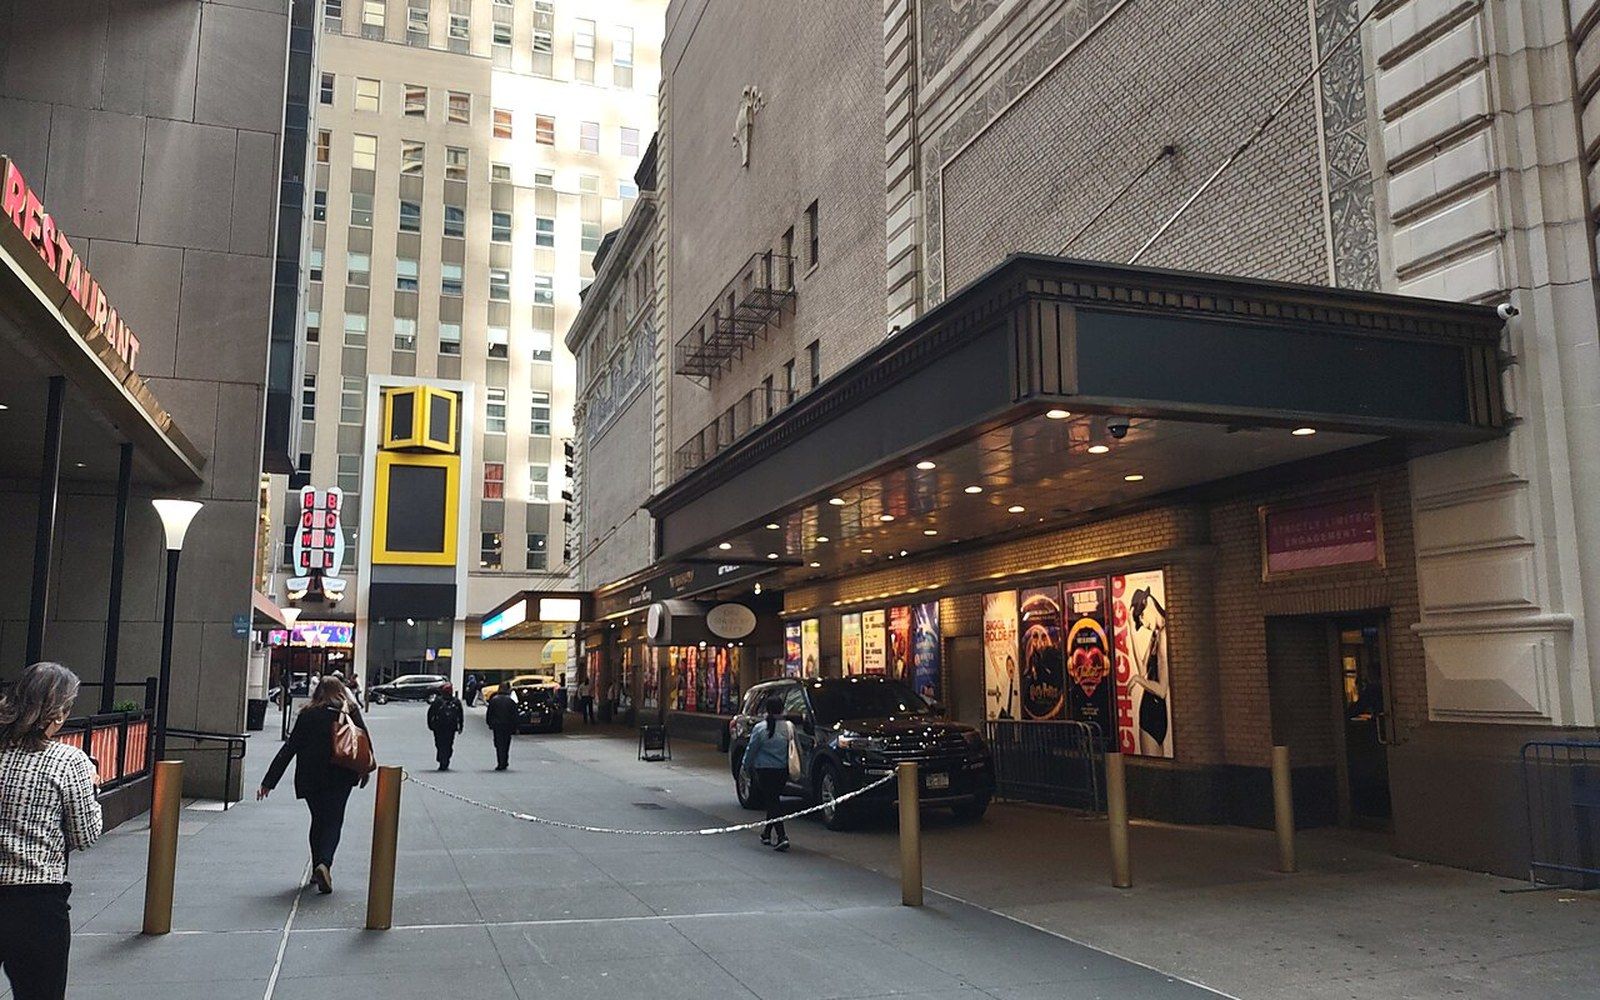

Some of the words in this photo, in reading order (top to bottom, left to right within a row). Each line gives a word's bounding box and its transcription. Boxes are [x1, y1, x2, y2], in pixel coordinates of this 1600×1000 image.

[2, 158, 140, 371] RESTAURANT
[302, 493, 313, 567] BOWL
[325, 494, 336, 567] BOWL
[1285, 528, 1357, 547] ENGAGEMENT
[1112, 574, 1136, 754] CHICAGO
